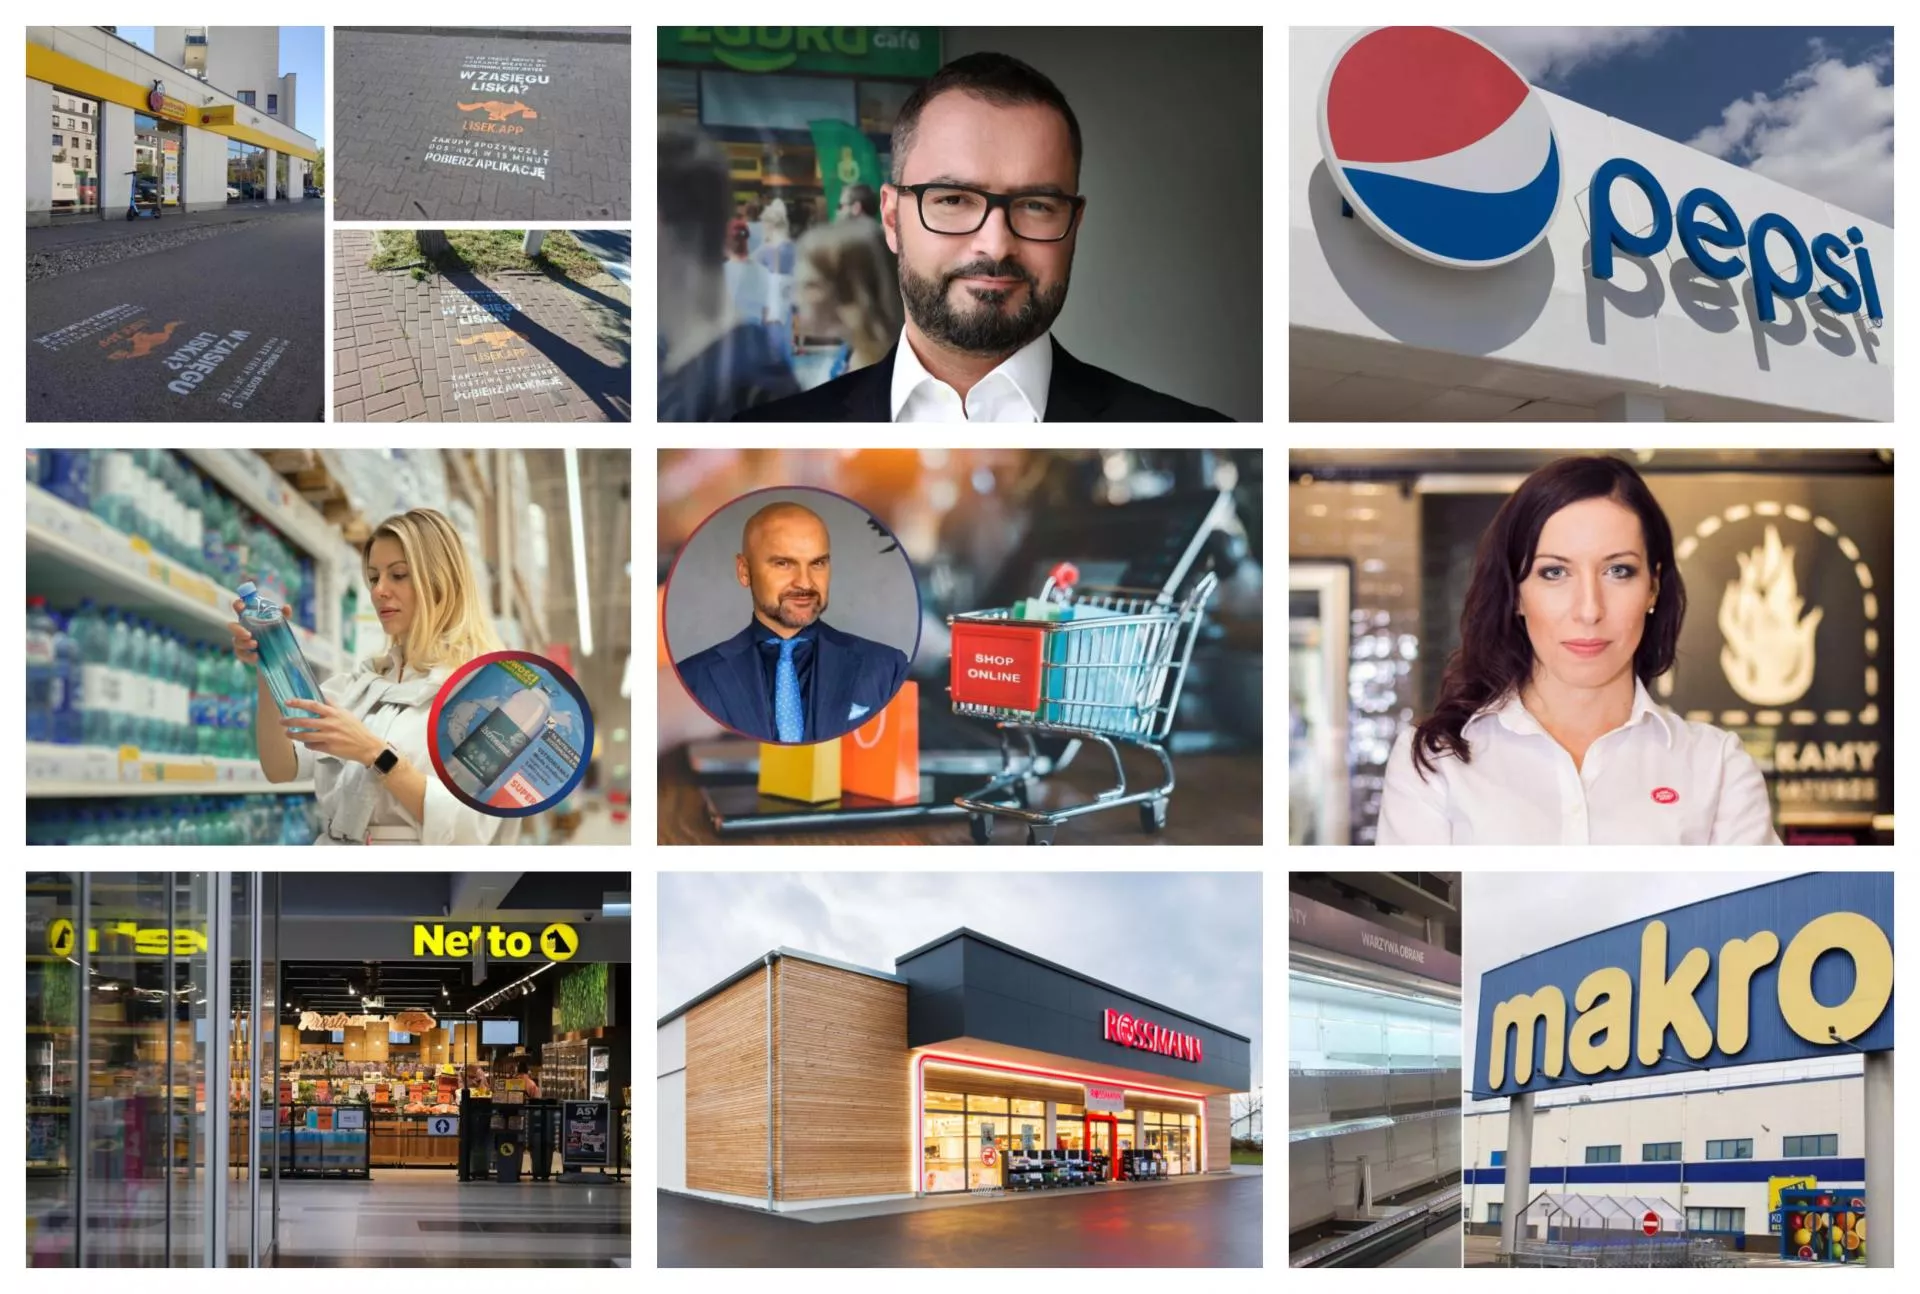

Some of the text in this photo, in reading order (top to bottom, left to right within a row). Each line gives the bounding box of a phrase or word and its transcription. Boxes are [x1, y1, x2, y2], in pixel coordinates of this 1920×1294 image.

[460, 70, 476, 80] W
[471, 82, 529, 95] LISKA?
[431, 136, 471, 147] ZAKUPY
[543, 149, 550, 157] Z
[424, 151, 546, 180] POBIERZ APLIKACJĘ
[512, 154, 550, 166] MINUT
[1589, 158, 1883, 323] pepsi
[228, 329, 252, 341] W
[162, 331, 219, 370] LISKA?
[975, 653, 1015, 666] SHOP
[967, 668, 1021, 684] ONLINE
[511, 780, 537, 804] SUPER
[1361, 931, 1425, 964] WARZYWA OBRANE
[1488, 911, 1894, 1090] makro
[1104, 1008, 1203, 1063] ROSSMANN
[576, 1107, 598, 1116] ASY
